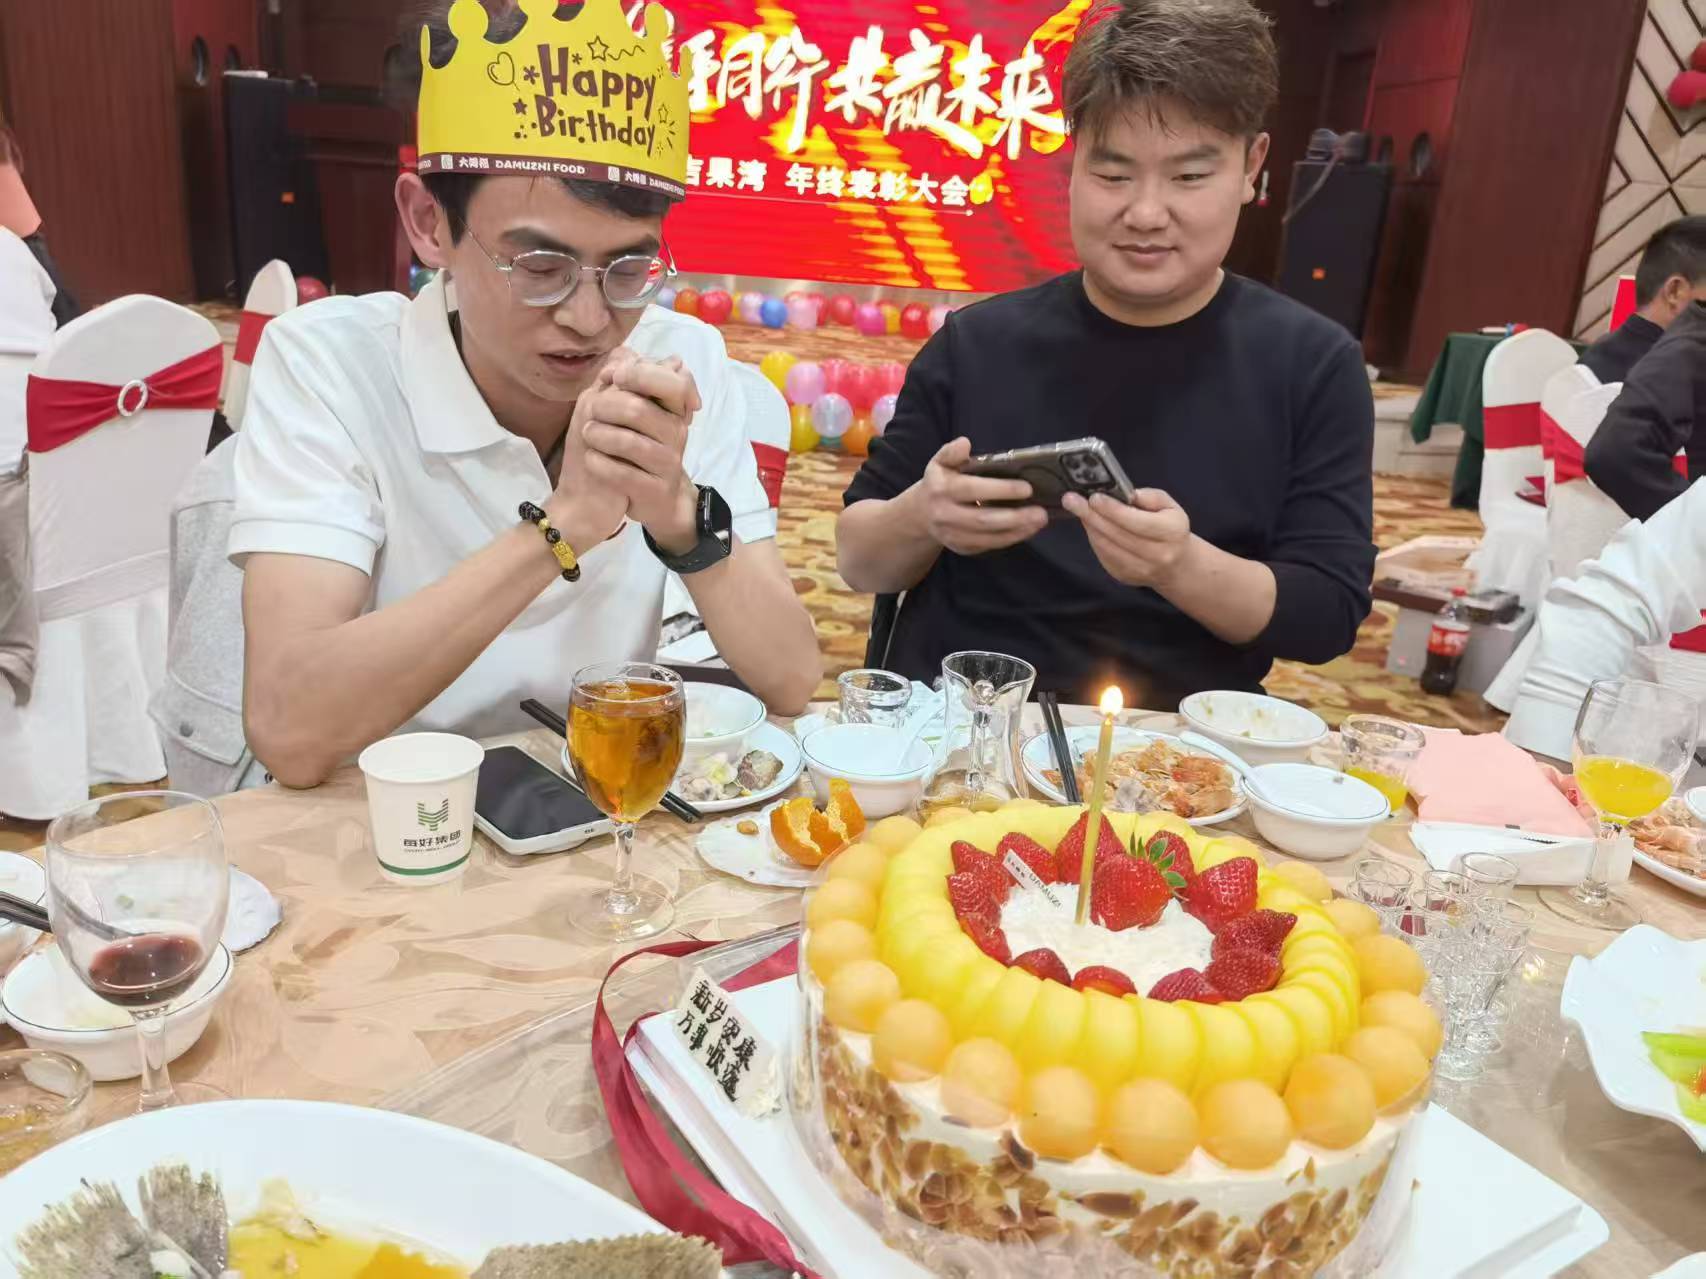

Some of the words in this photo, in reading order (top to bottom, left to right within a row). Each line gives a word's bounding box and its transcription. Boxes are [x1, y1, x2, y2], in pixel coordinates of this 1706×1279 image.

[537, 43, 657, 121] Happy
[534, 94, 656, 157] Birthday
[495, 159, 551, 172] DAMUZHI
[553, 162, 586, 175] FOOD
[784, 162, 970, 207] 年终表彰大会
